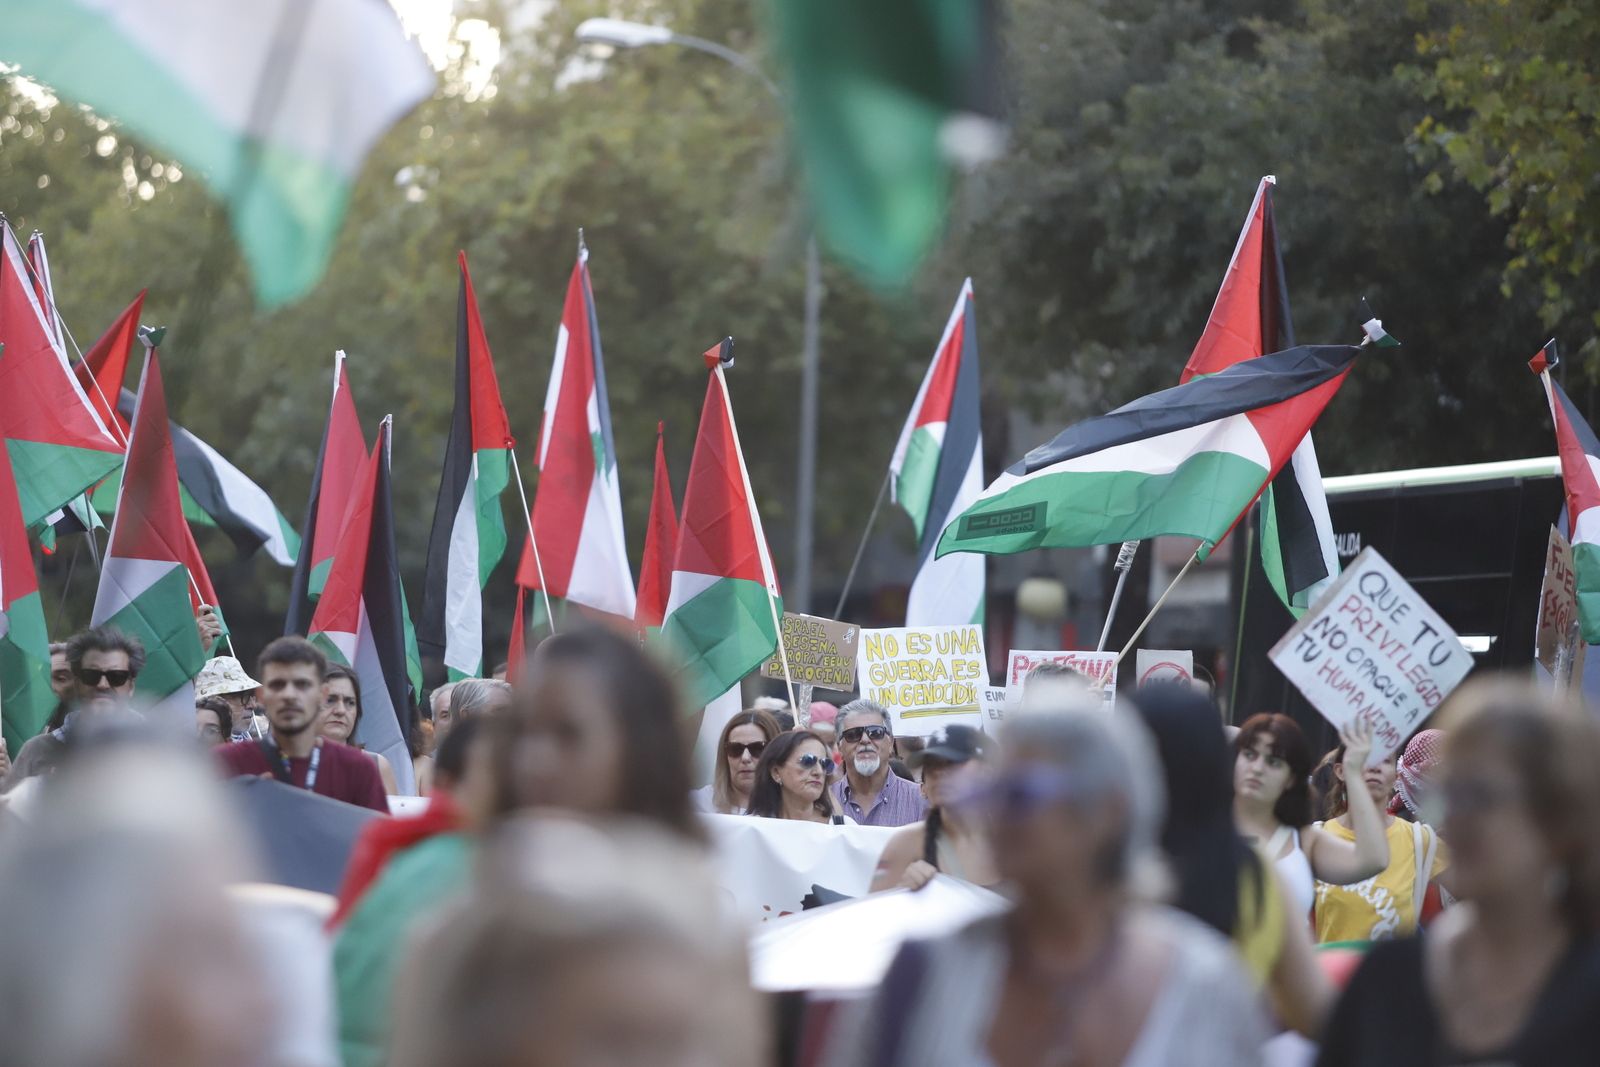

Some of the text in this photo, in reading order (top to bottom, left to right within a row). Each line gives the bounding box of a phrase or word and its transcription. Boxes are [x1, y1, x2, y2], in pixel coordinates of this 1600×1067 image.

[1551, 544, 1578, 606] FUE
[783, 617, 827, 638] SRAEL
[1358, 571, 1452, 668] QUE TU
[783, 633, 838, 655] SESINA
[865, 628, 981, 661] NO ES UNA
[1295, 632, 1322, 662] TU
[1338, 594, 1443, 708] PRIVILEGIO
[1312, 615, 1348, 650] NO
[1404, 707, 1419, 725] A
[869, 685, 897, 707] UN
[985, 691, 1007, 702] EUR
